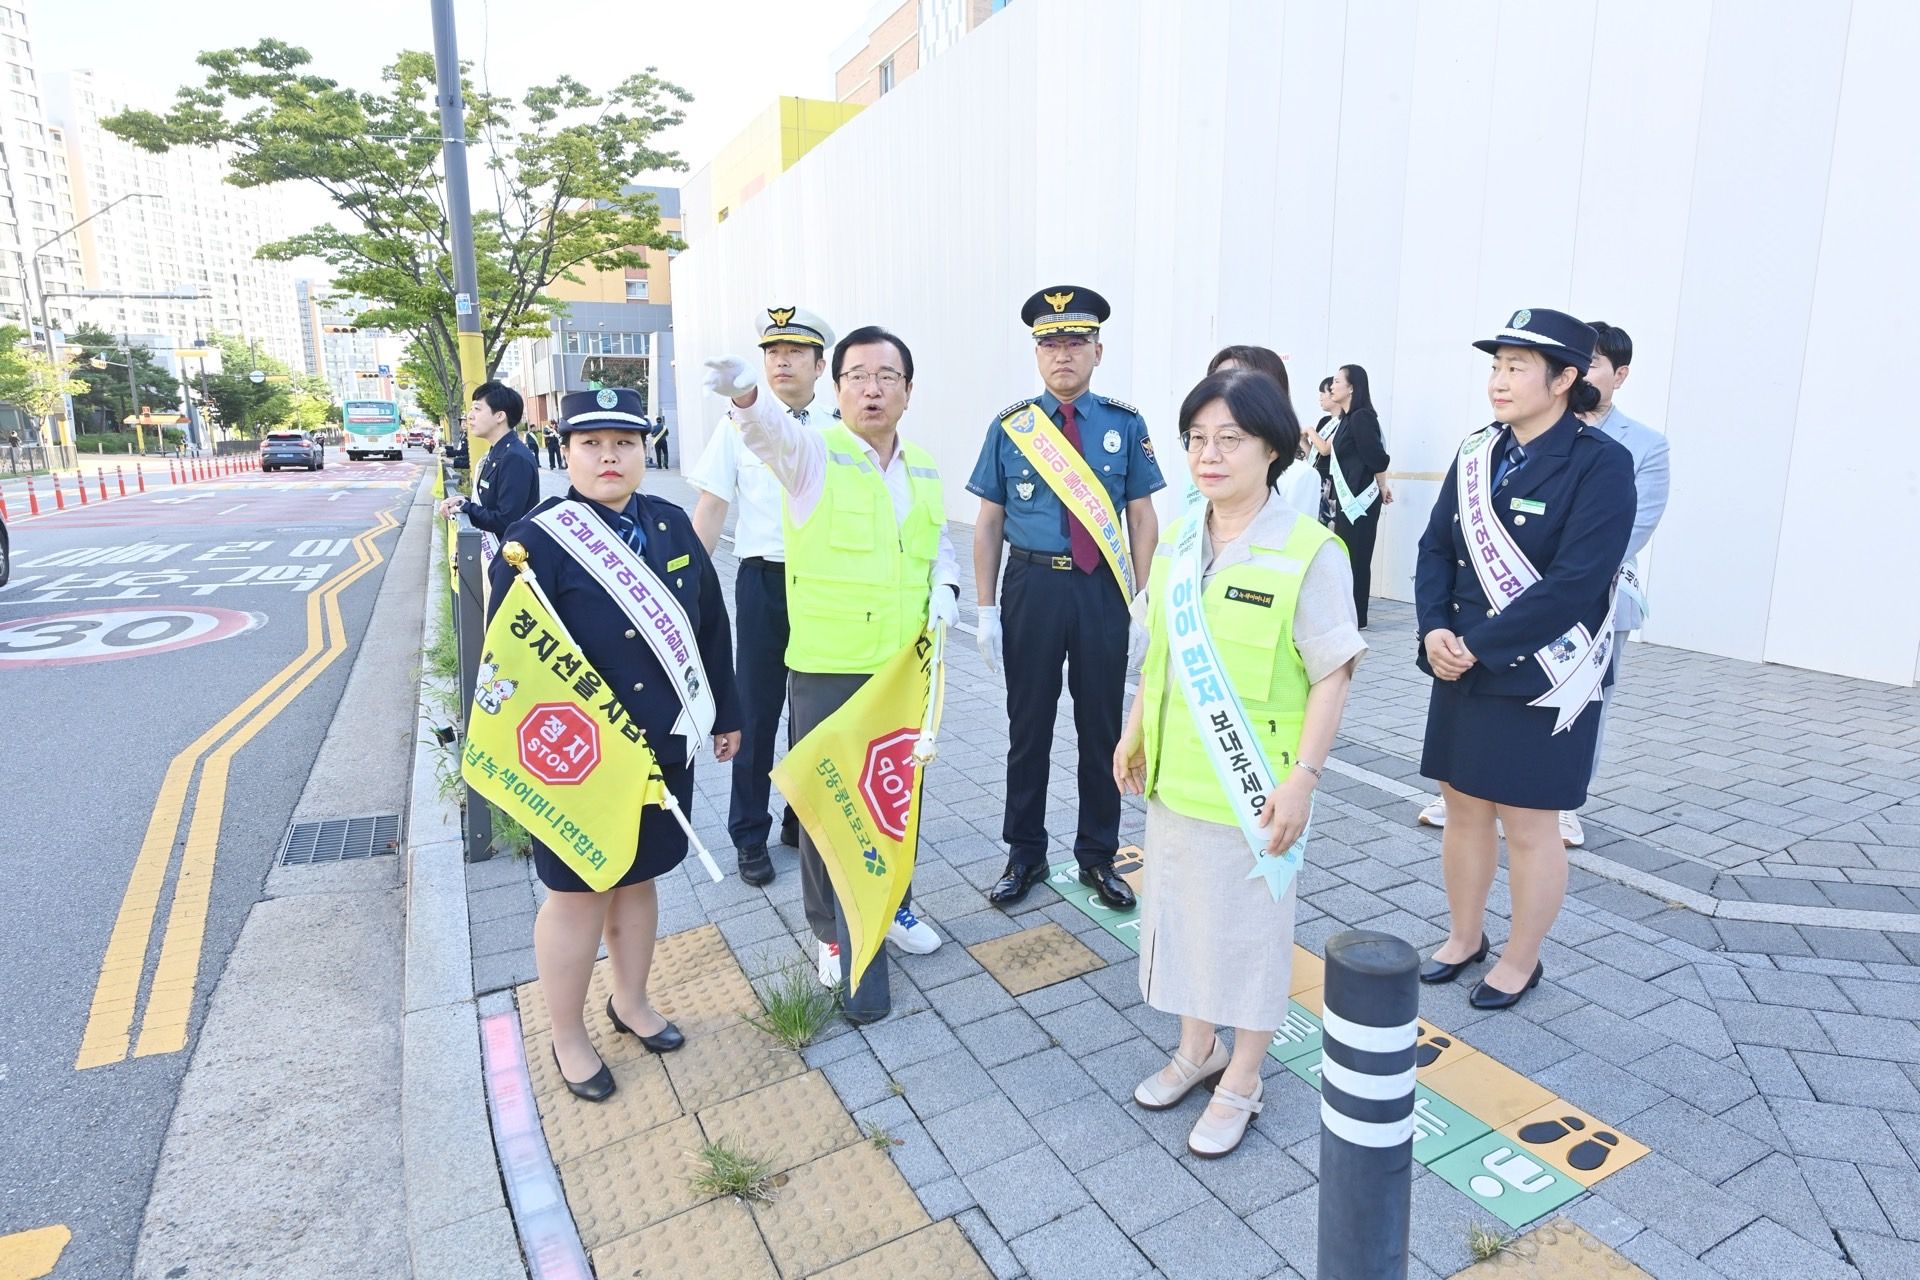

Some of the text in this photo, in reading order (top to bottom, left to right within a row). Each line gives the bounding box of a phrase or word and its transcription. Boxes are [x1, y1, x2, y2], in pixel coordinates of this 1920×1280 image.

[1032, 433, 1069, 474] 어린이
[1464, 457, 1526, 604] 하남녹색어머니연
[2, 563, 332, 604] 보호구역
[555, 508, 688, 667] 하남녹색어머니연합회
[1172, 577, 1197, 637] 아이
[0, 615, 194, 652] 30
[510, 608, 602, 701] 정지선을
[1181, 643, 1225, 706] 먼저
[527, 737, 569, 774] STOP
[464, 738, 607, 871] 남녹색어머니연합회
